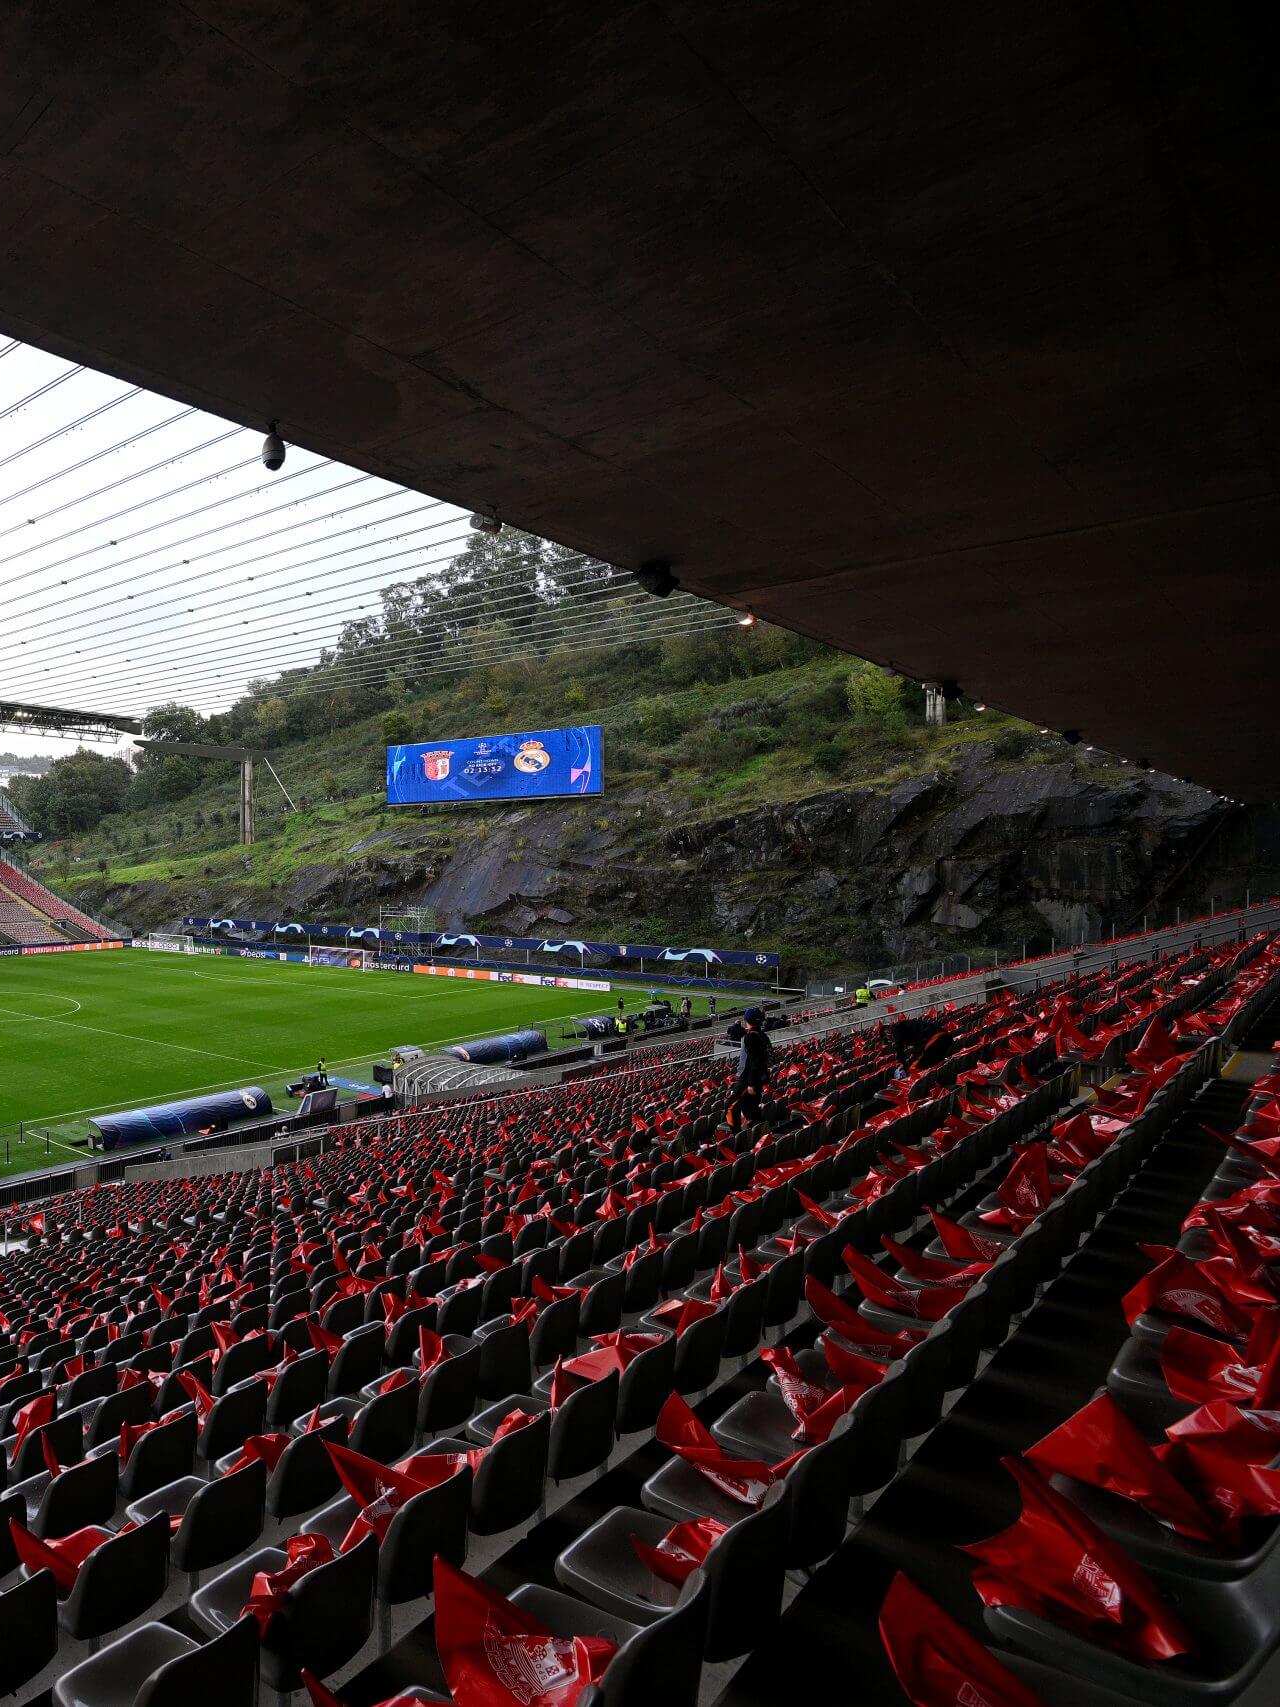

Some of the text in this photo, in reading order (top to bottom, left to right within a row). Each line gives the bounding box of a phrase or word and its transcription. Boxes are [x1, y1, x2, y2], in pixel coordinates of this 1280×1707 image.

[246, 950, 266, 959] pepsi
[498, 973, 525, 983] FedEx
[540, 977, 568, 988] FedEx
